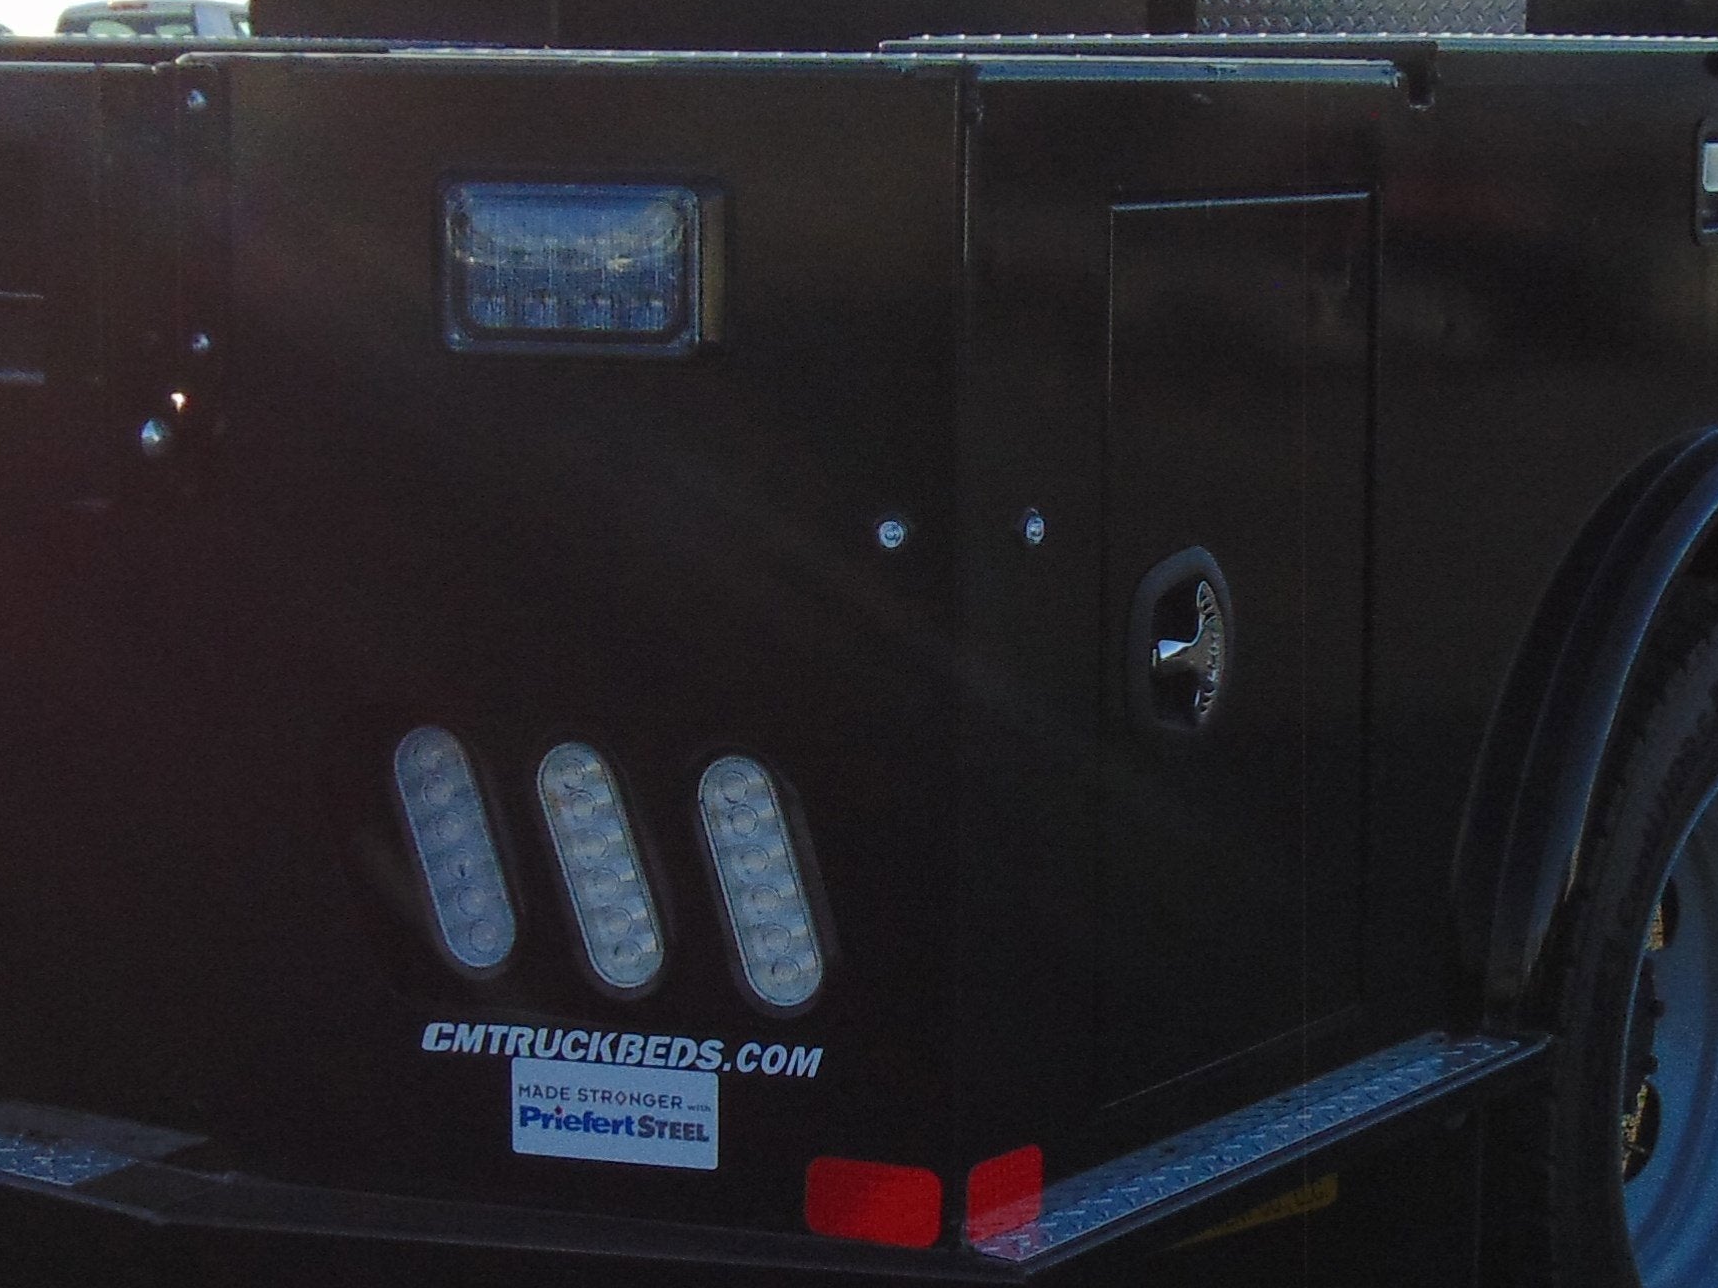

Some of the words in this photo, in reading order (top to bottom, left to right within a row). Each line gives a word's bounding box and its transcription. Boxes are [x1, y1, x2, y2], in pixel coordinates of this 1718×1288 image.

[421, 1021, 824, 1078] CMTRUCKBEDS.COM
[517, 1082, 571, 1102] MADE
[577, 1088, 683, 1110] STRONGER
[686, 1102, 712, 1113] with
